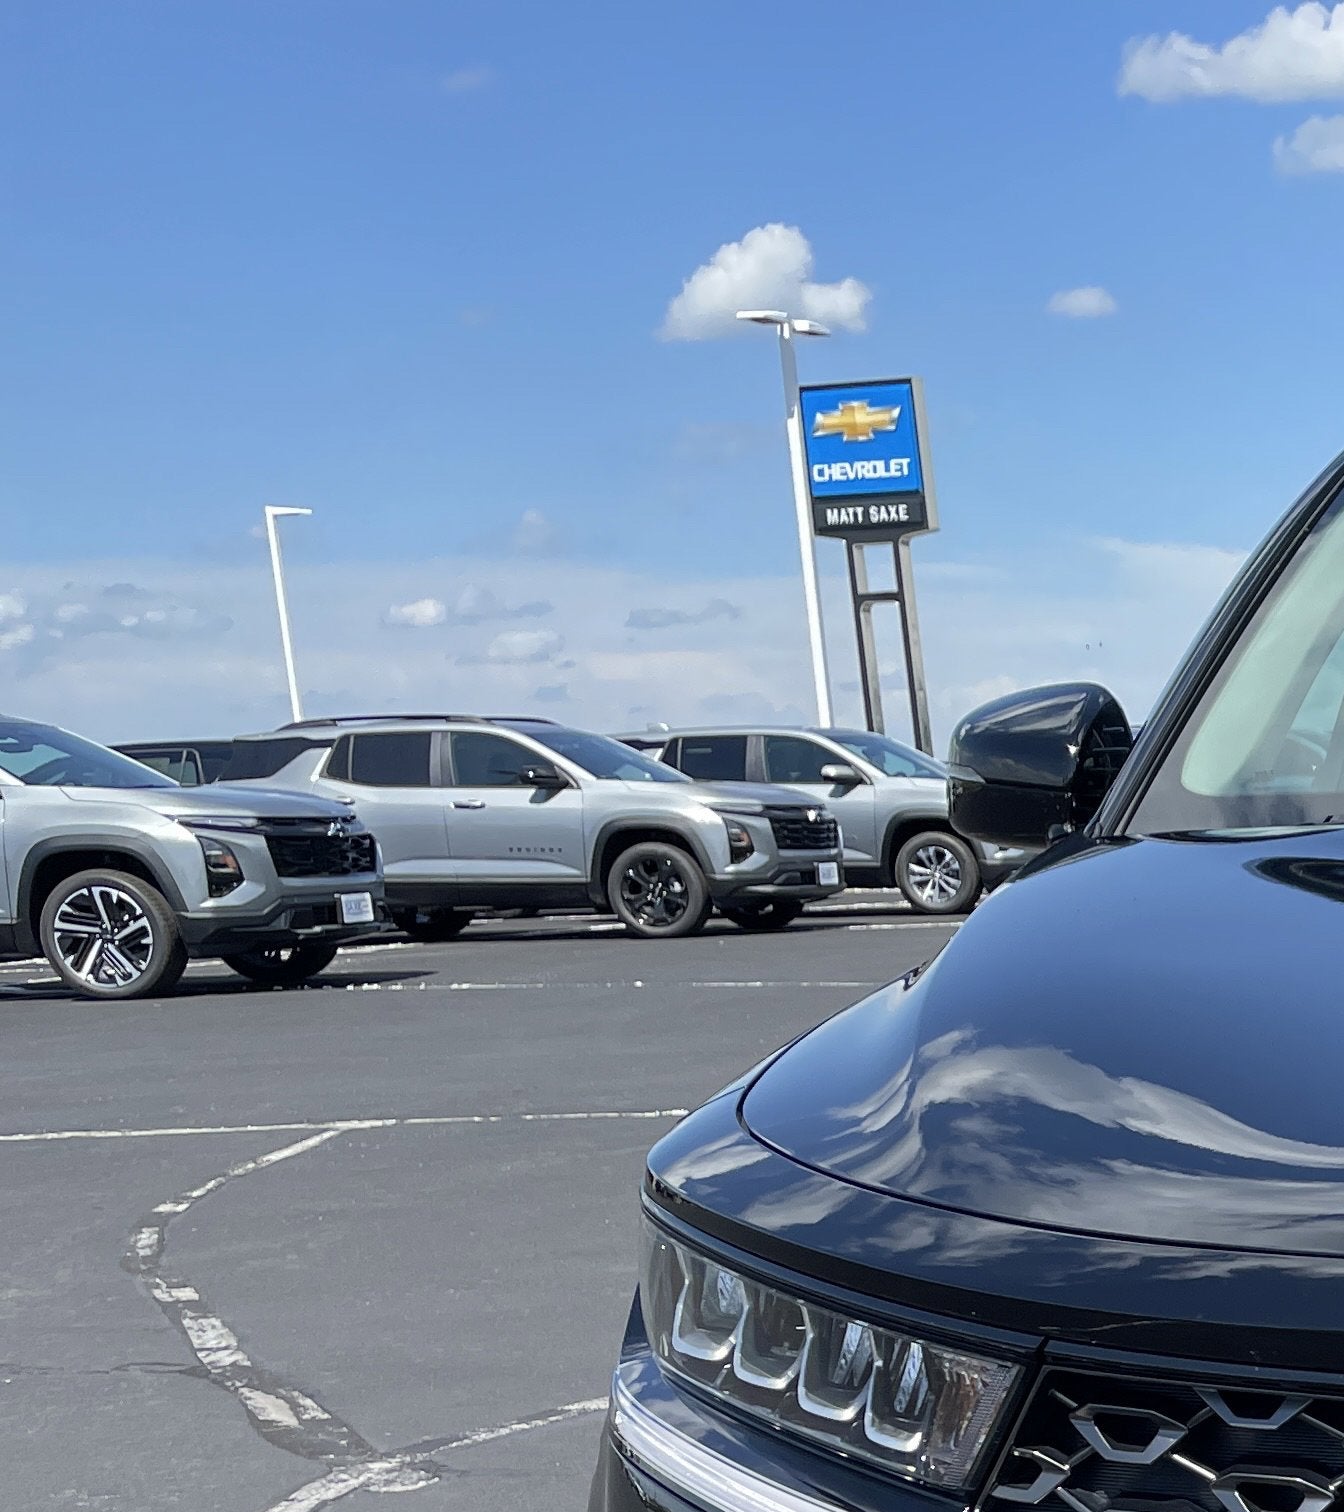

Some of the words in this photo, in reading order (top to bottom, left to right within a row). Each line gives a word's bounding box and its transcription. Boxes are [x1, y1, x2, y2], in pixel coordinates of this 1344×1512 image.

[812, 457, 911, 482] CHEVROLET
[826, 506, 864, 525] MATT
[869, 503, 910, 523] SAXE
